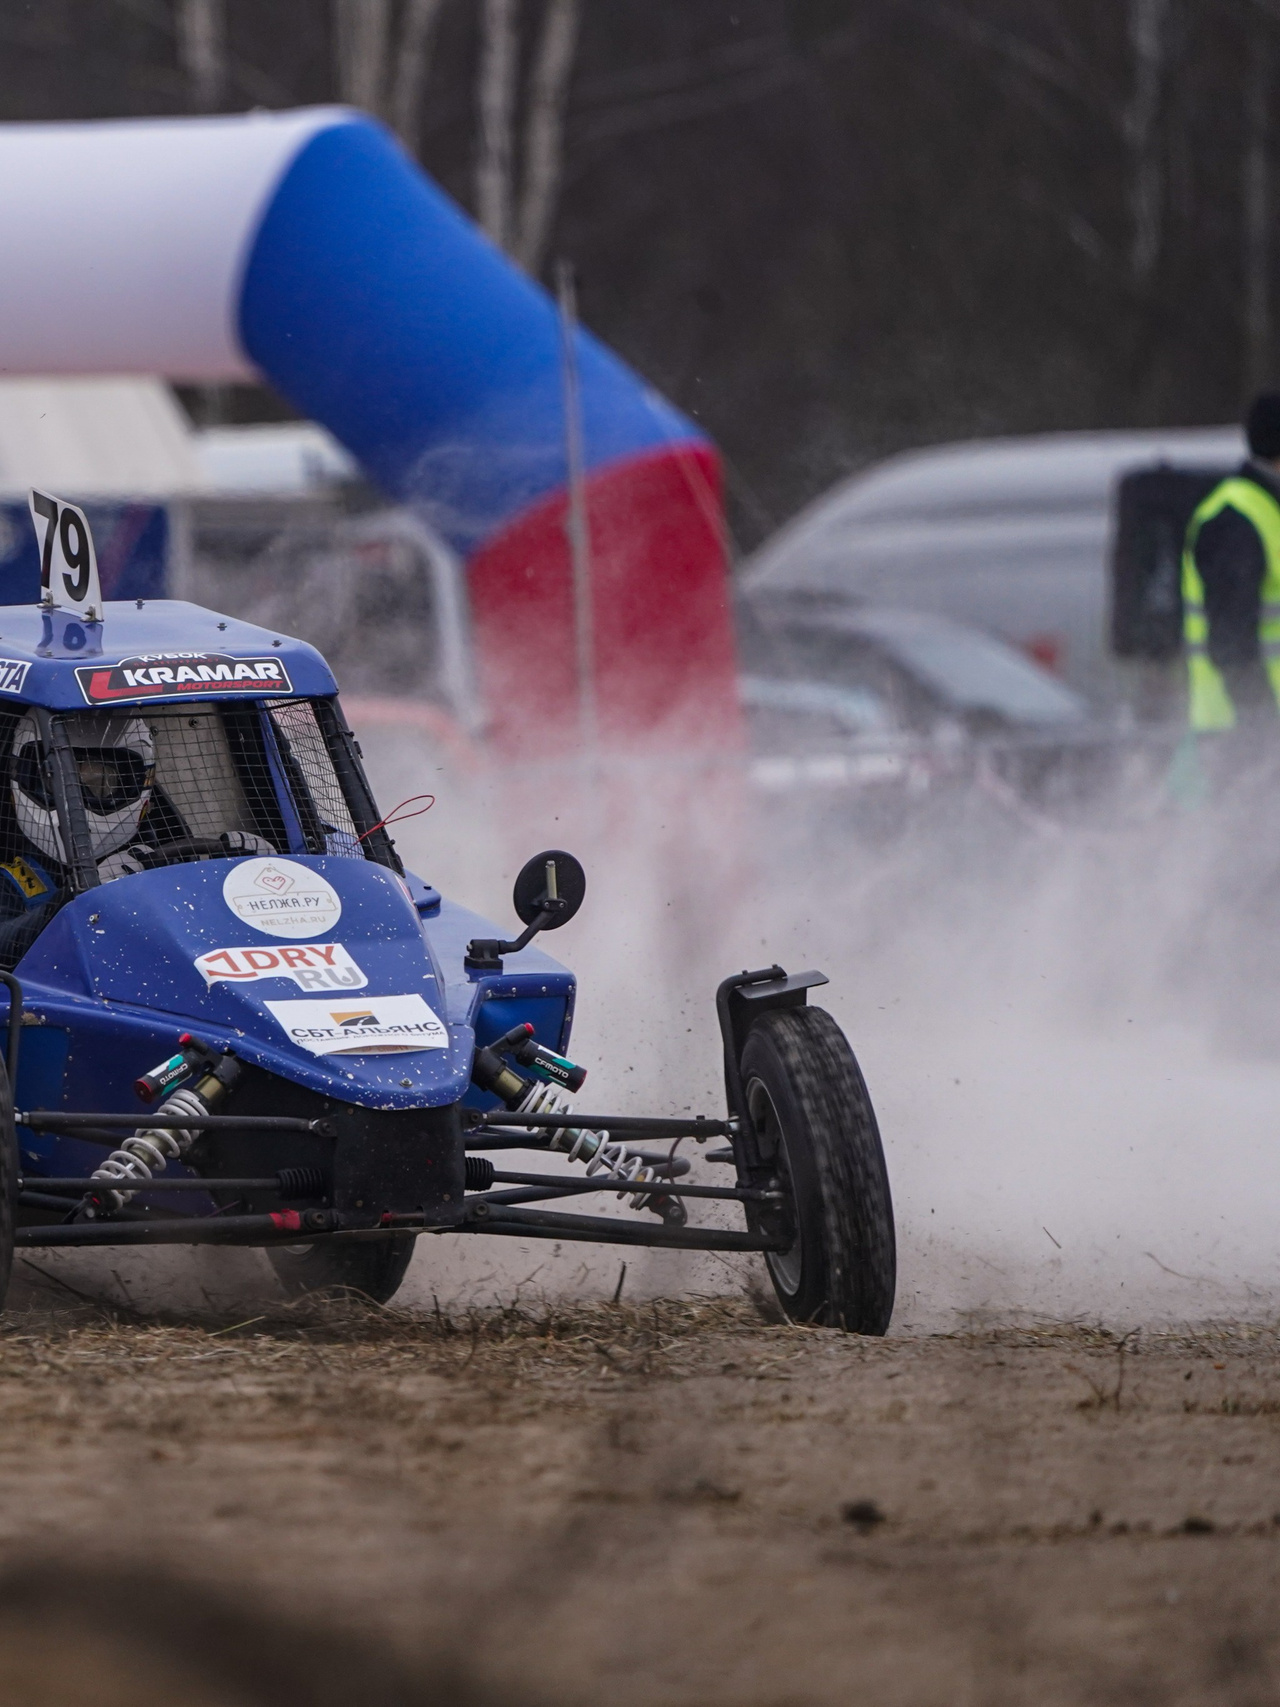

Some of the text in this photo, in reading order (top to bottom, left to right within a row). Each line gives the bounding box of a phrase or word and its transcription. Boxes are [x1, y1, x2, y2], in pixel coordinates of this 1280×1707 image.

[33, 489, 90, 602] 79
[138, 652, 207, 662] КУБОК
[123, 662, 283, 687] KRAMAR
[176, 680, 284, 692] MOTORSPORT
[248, 896, 321, 911] НЕЛЖА.РУ
[261, 915, 327, 927] NELZHA.RU
[203, 946, 337, 977] 1DRY
[293, 966, 362, 989] RU
[291, 1021, 441, 1038] СБТ-АЛЬЯНС
[534, 1057, 569, 1079] CFMOTO
